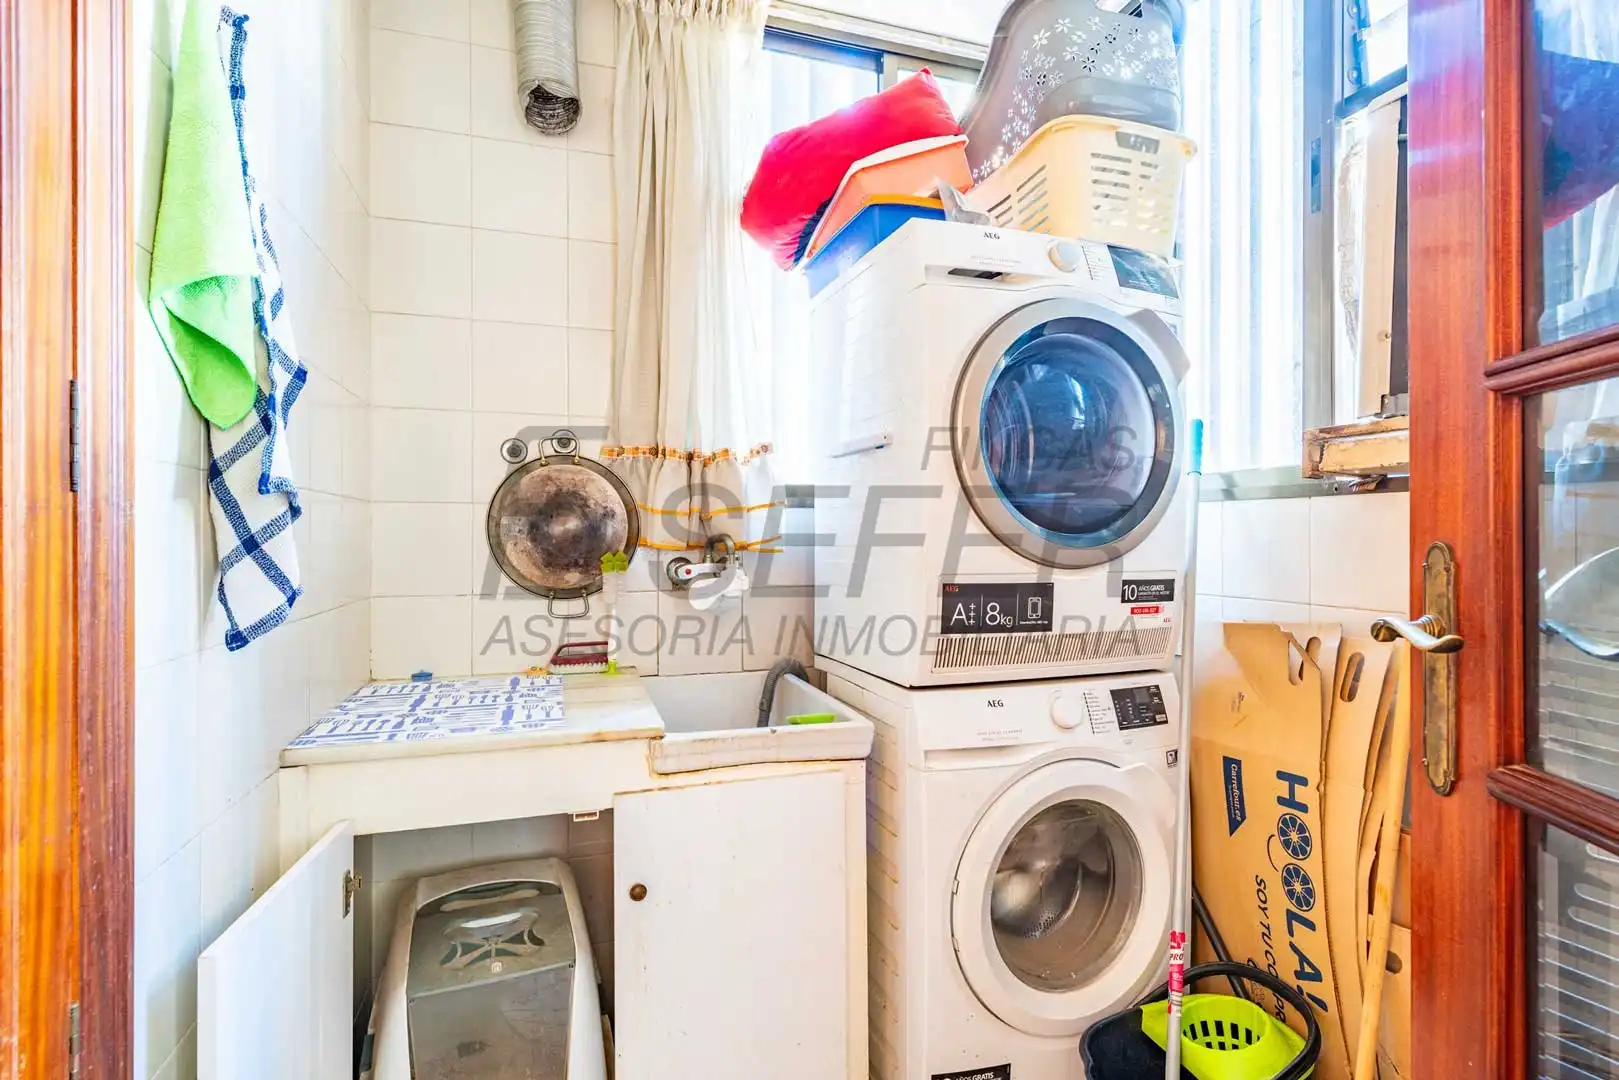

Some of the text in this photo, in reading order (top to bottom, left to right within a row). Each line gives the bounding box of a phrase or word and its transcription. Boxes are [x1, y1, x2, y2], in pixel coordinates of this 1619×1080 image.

[983, 231, 1001, 241] AEG
[1123, 584, 1138, 601] 10
[987, 699, 1004, 708] AEG
[1255, 874, 1269, 920] SOY
[1260, 921, 1274, 950] TU
